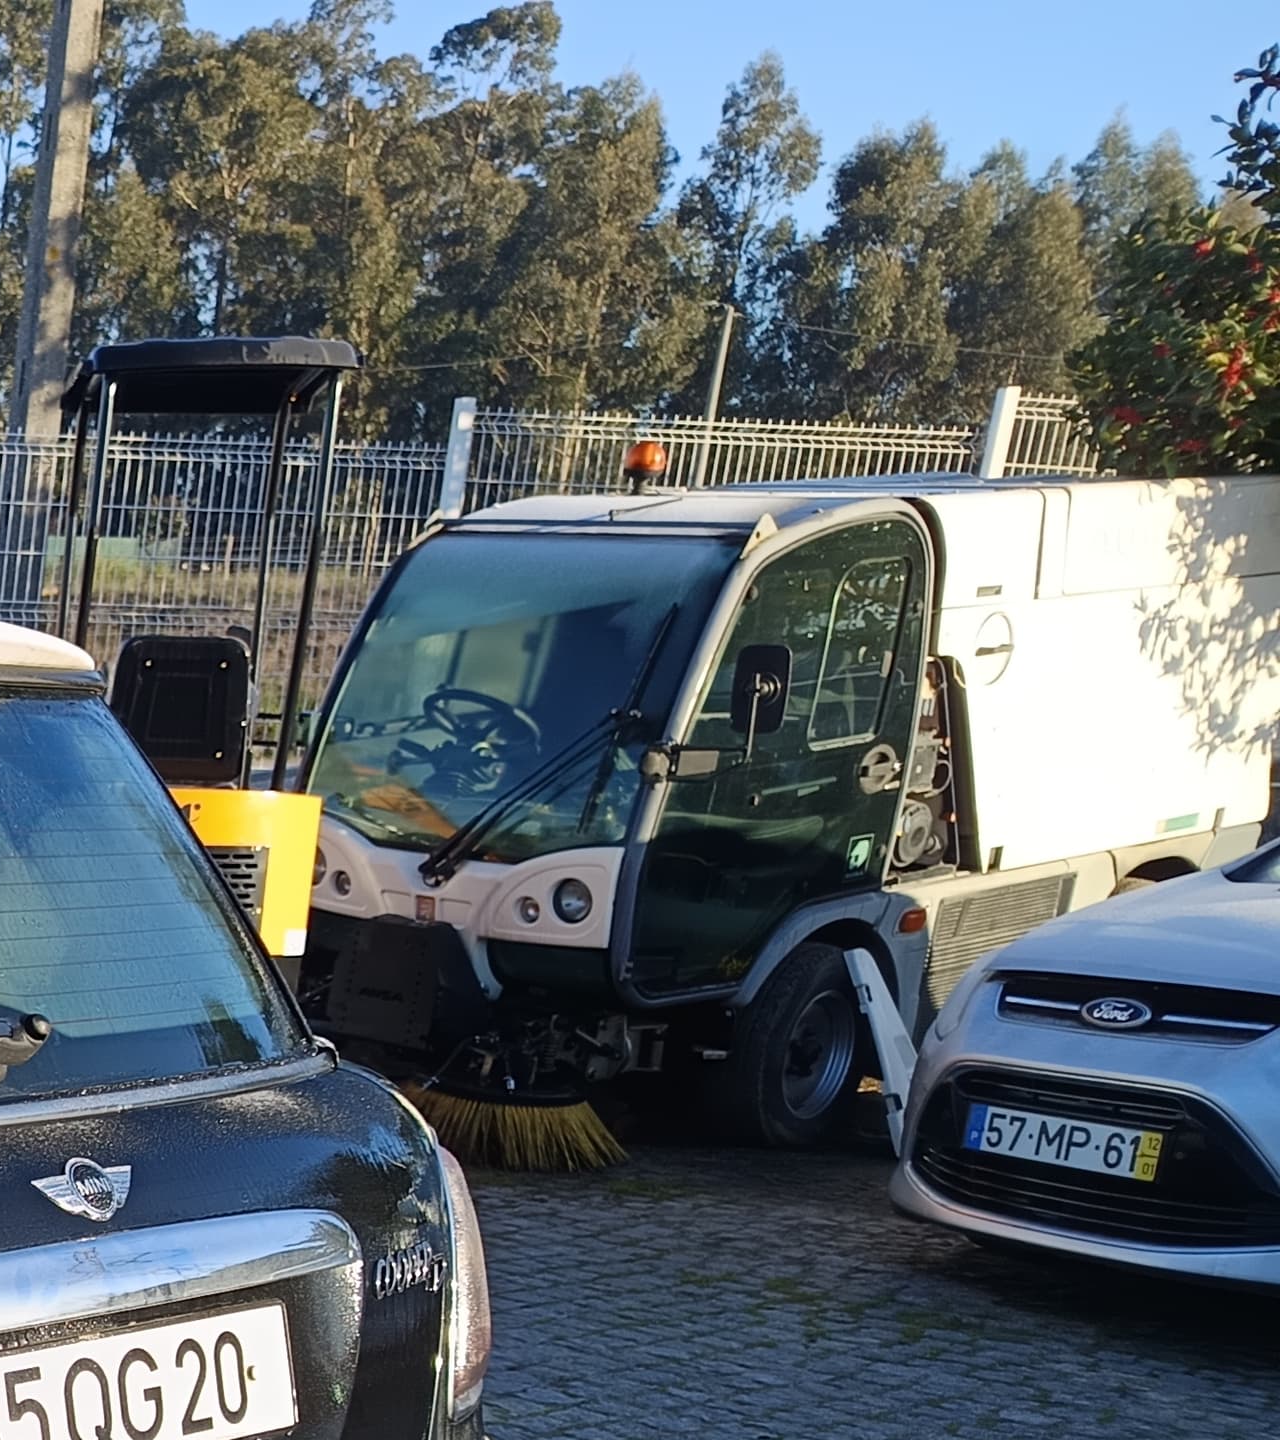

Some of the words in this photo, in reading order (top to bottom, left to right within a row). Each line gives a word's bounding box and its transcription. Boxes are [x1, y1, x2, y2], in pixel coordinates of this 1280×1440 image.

[1093, 1001, 1135, 1021] Ford
[1148, 1136, 1161, 1151] 12
[75, 1175, 113, 1197] MINI
